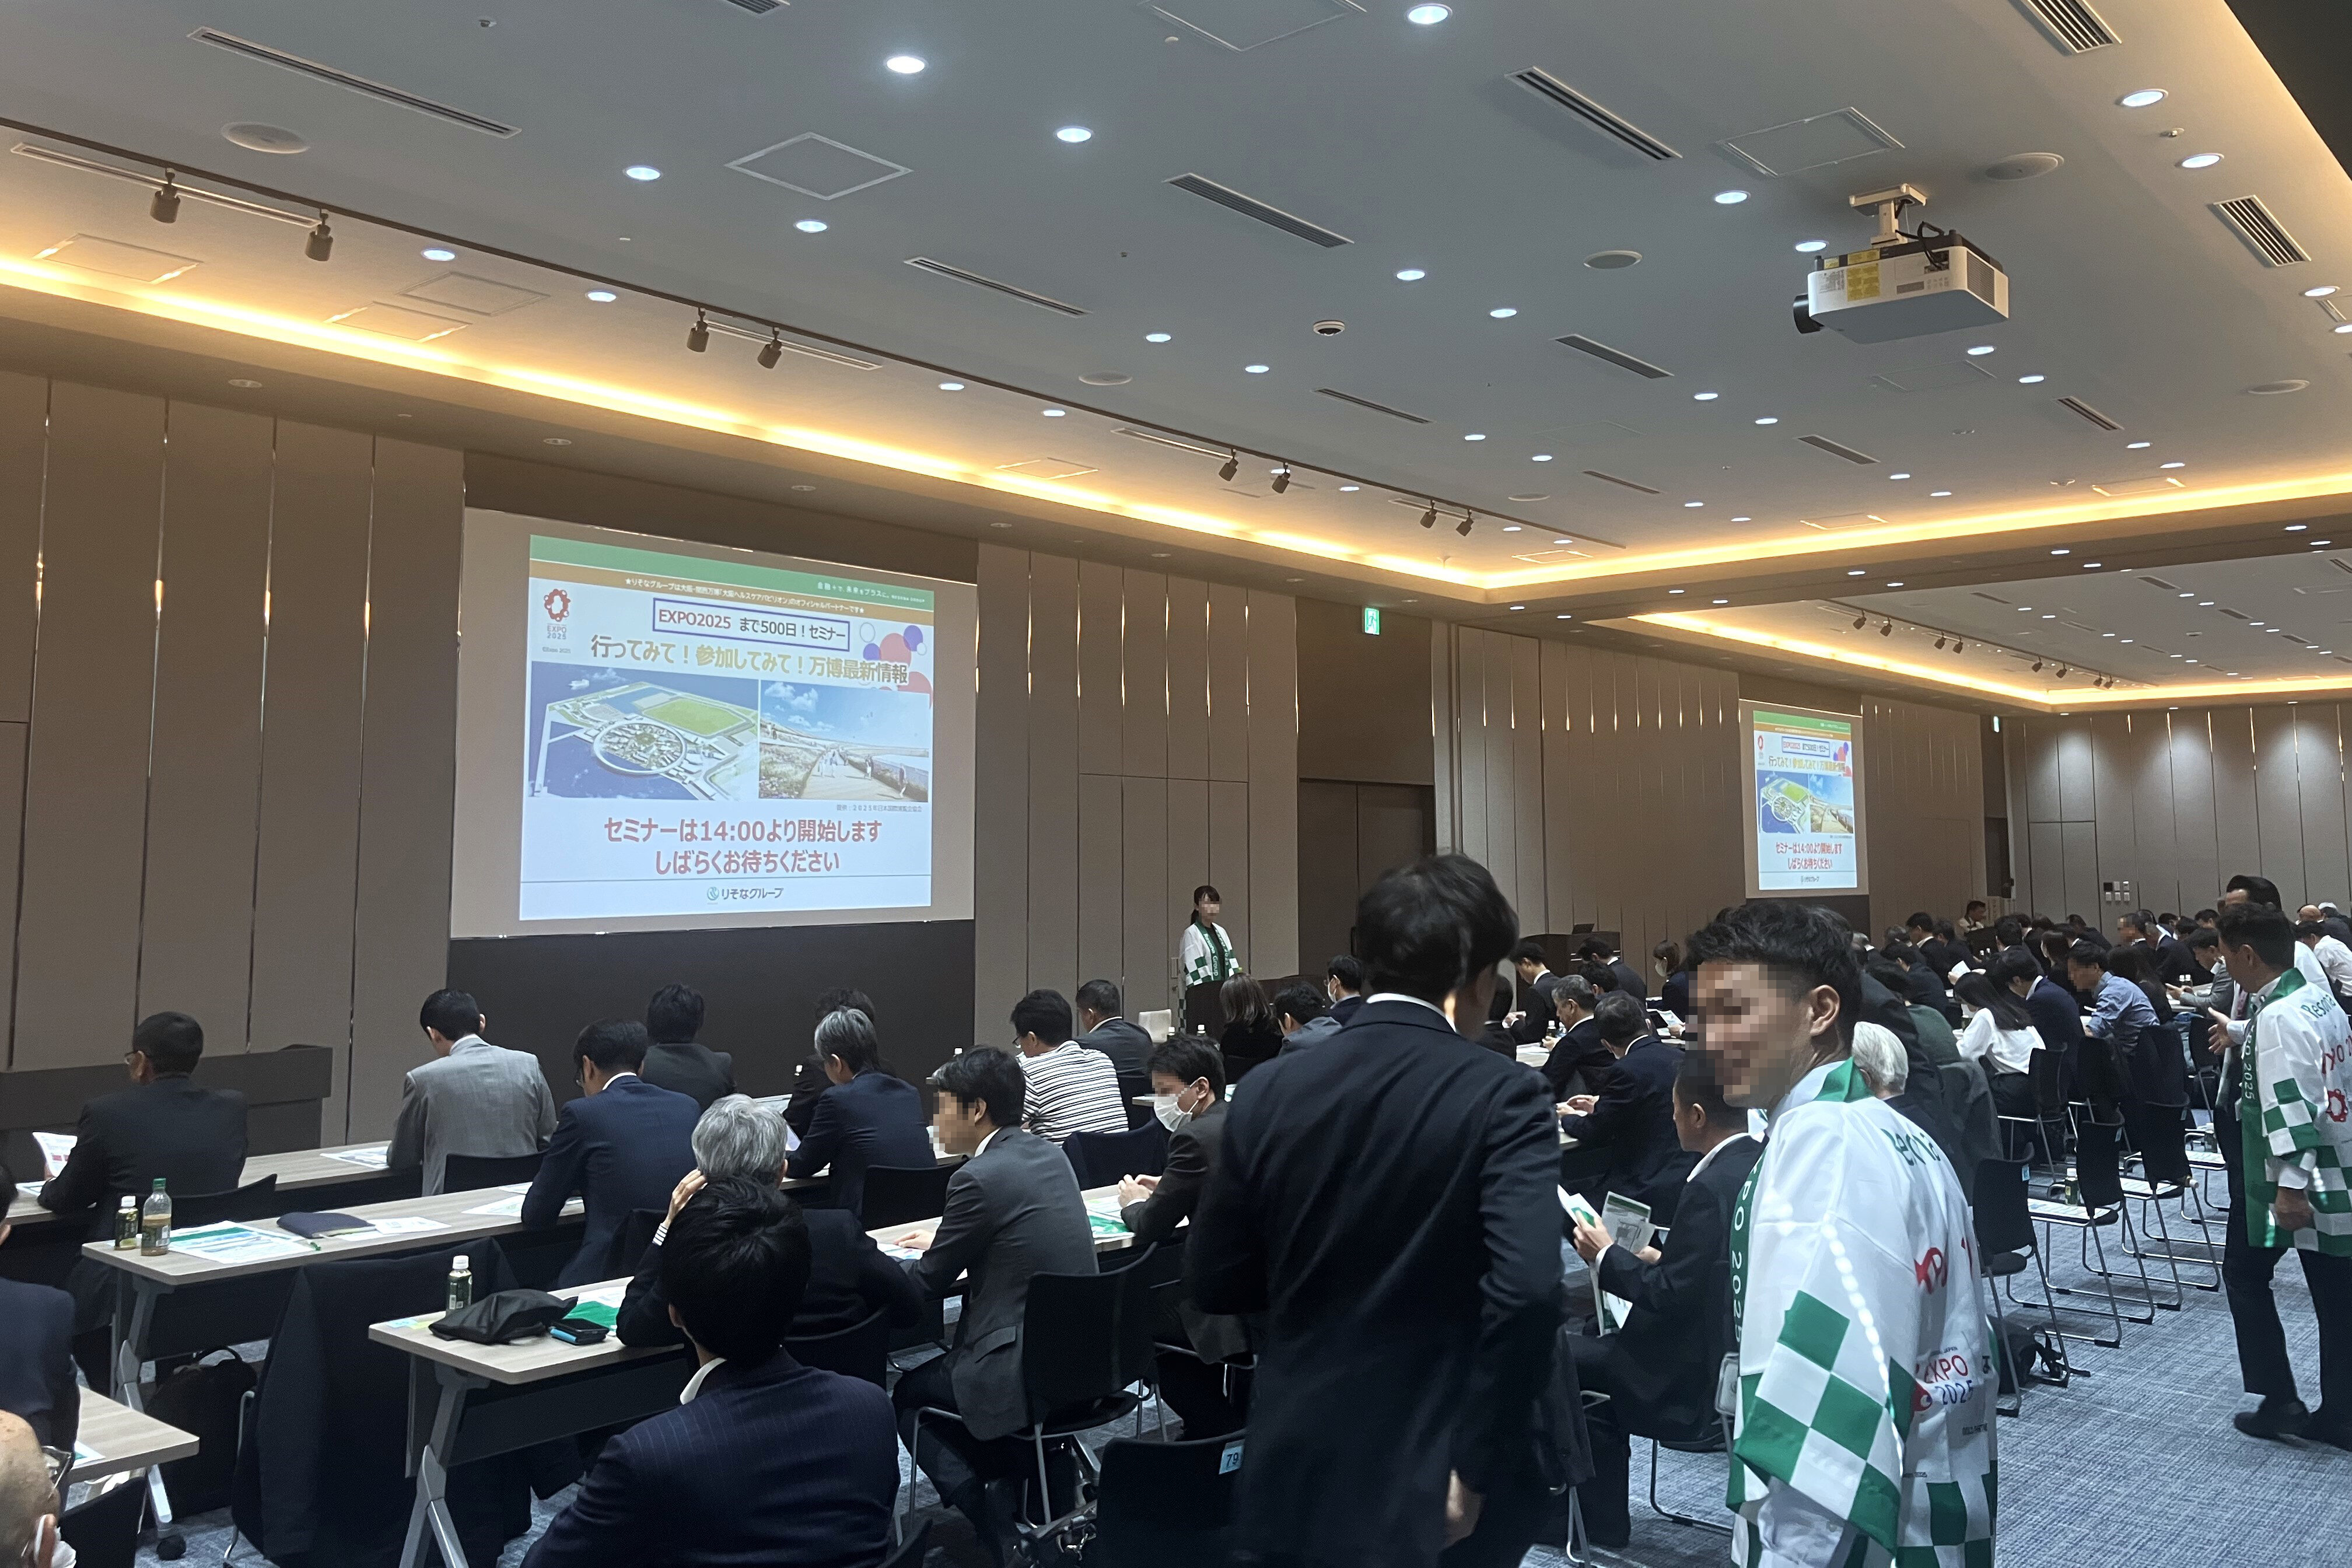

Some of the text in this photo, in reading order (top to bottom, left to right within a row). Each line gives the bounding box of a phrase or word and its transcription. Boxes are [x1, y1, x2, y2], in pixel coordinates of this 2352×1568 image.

[547, 625, 567, 634] EXPO
[659, 609, 732, 629] EXPO2025
[547, 632, 567, 640] 2025
[604, 817, 883, 843] セミナーは14:00より開始します
[656, 849, 840, 875] しばらくお待ちください
[721, 887, 784, 900] りそなグループ
[2244, 1063, 2255, 1100] 2025
[1731, 1250, 1742, 1343] 2025
[1934, 1380, 1974, 1405] 2025
[1227, 1452, 1239, 1467] 79
